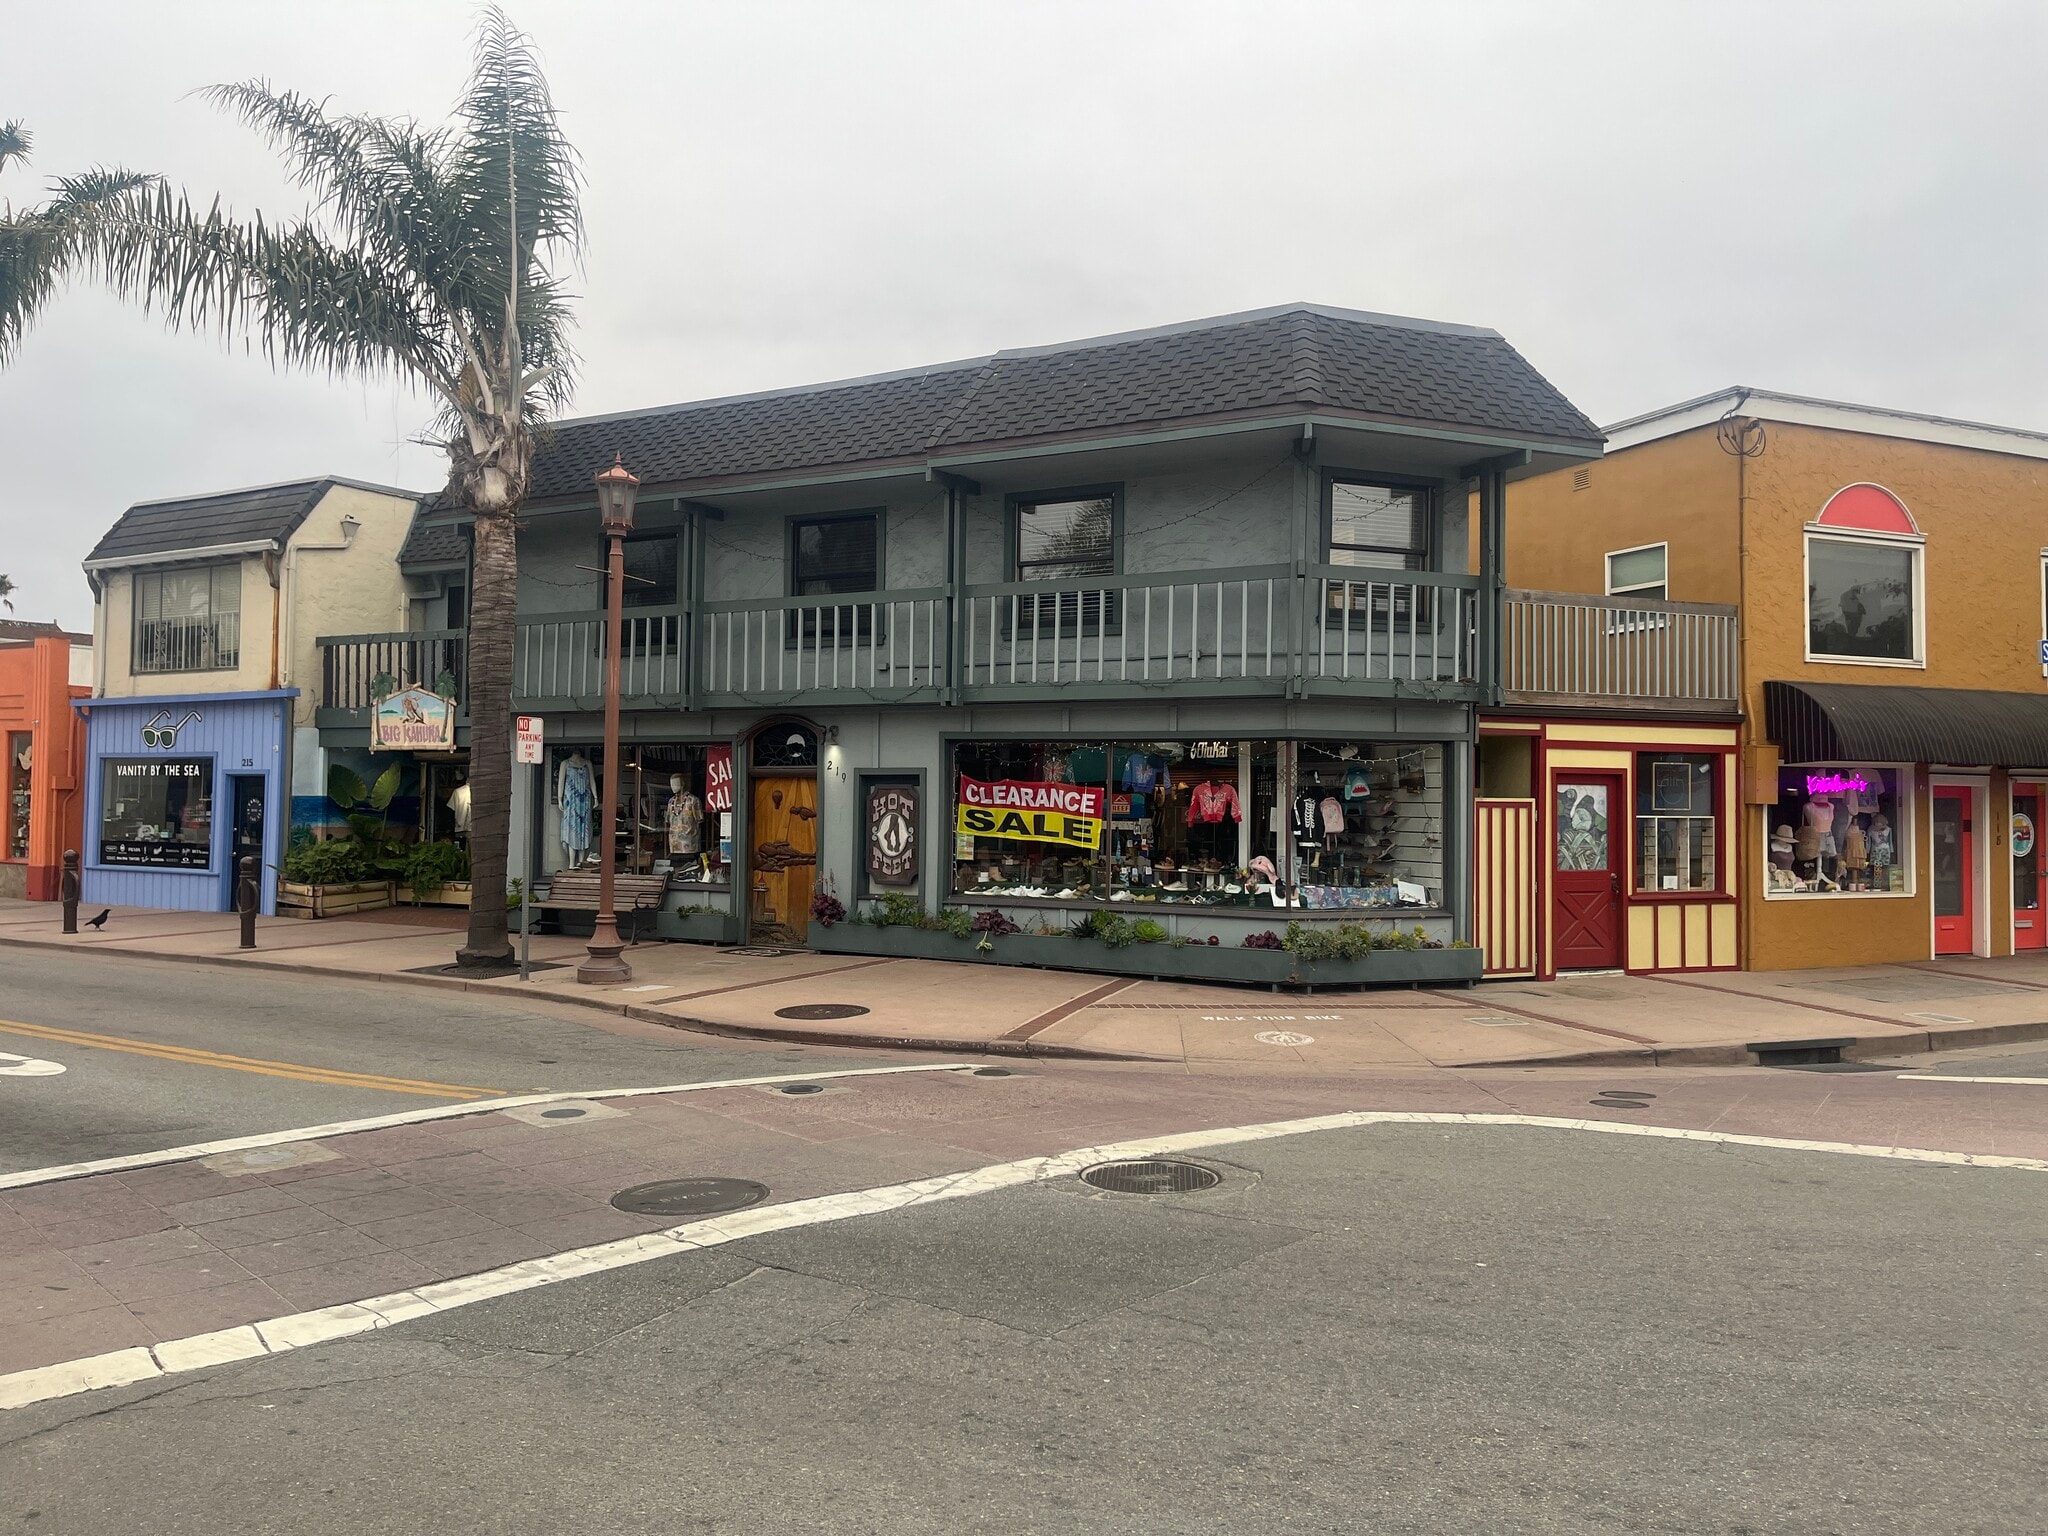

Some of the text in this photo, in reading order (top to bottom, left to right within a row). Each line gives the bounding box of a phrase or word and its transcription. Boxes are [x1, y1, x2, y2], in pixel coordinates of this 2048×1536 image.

[381, 724, 440, 743] BIG KAHUNA
[518, 718, 529, 730] NO
[518, 733, 542, 743] PARKING
[117, 765, 200, 776] VANITY BY THE SEA
[242, 759, 253, 767] 215
[827, 760, 846, 783] 219
[873, 793, 914, 822] HOT
[966, 784, 1096, 814] CLEARANCE
[964, 809, 1093, 843] SALE
[873, 847, 912, 876] FEET
